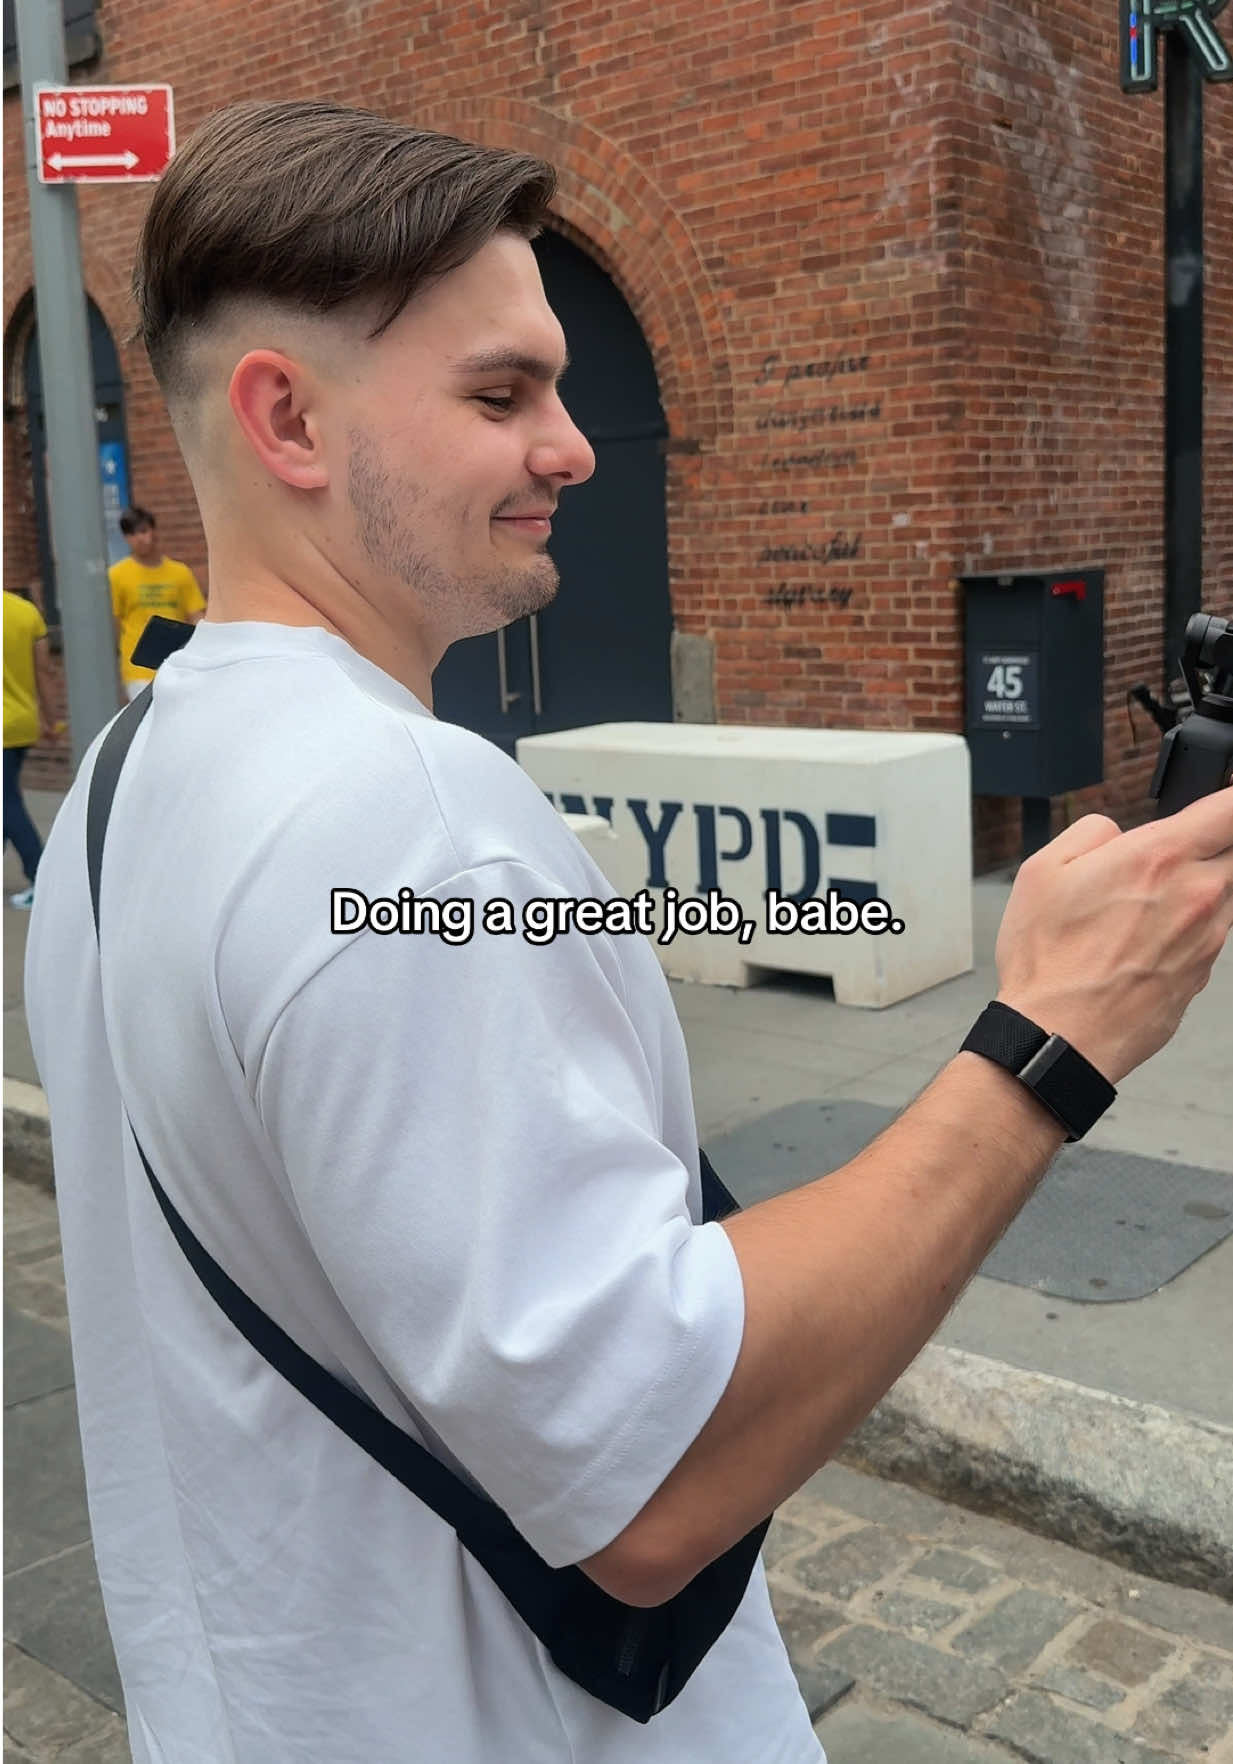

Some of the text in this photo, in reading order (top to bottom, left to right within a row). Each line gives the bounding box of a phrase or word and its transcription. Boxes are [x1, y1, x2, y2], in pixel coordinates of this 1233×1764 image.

[43, 95, 148, 118] NO STOPPING
[45, 118, 112, 142] Anytime
[986, 665, 1023, 699] 45
